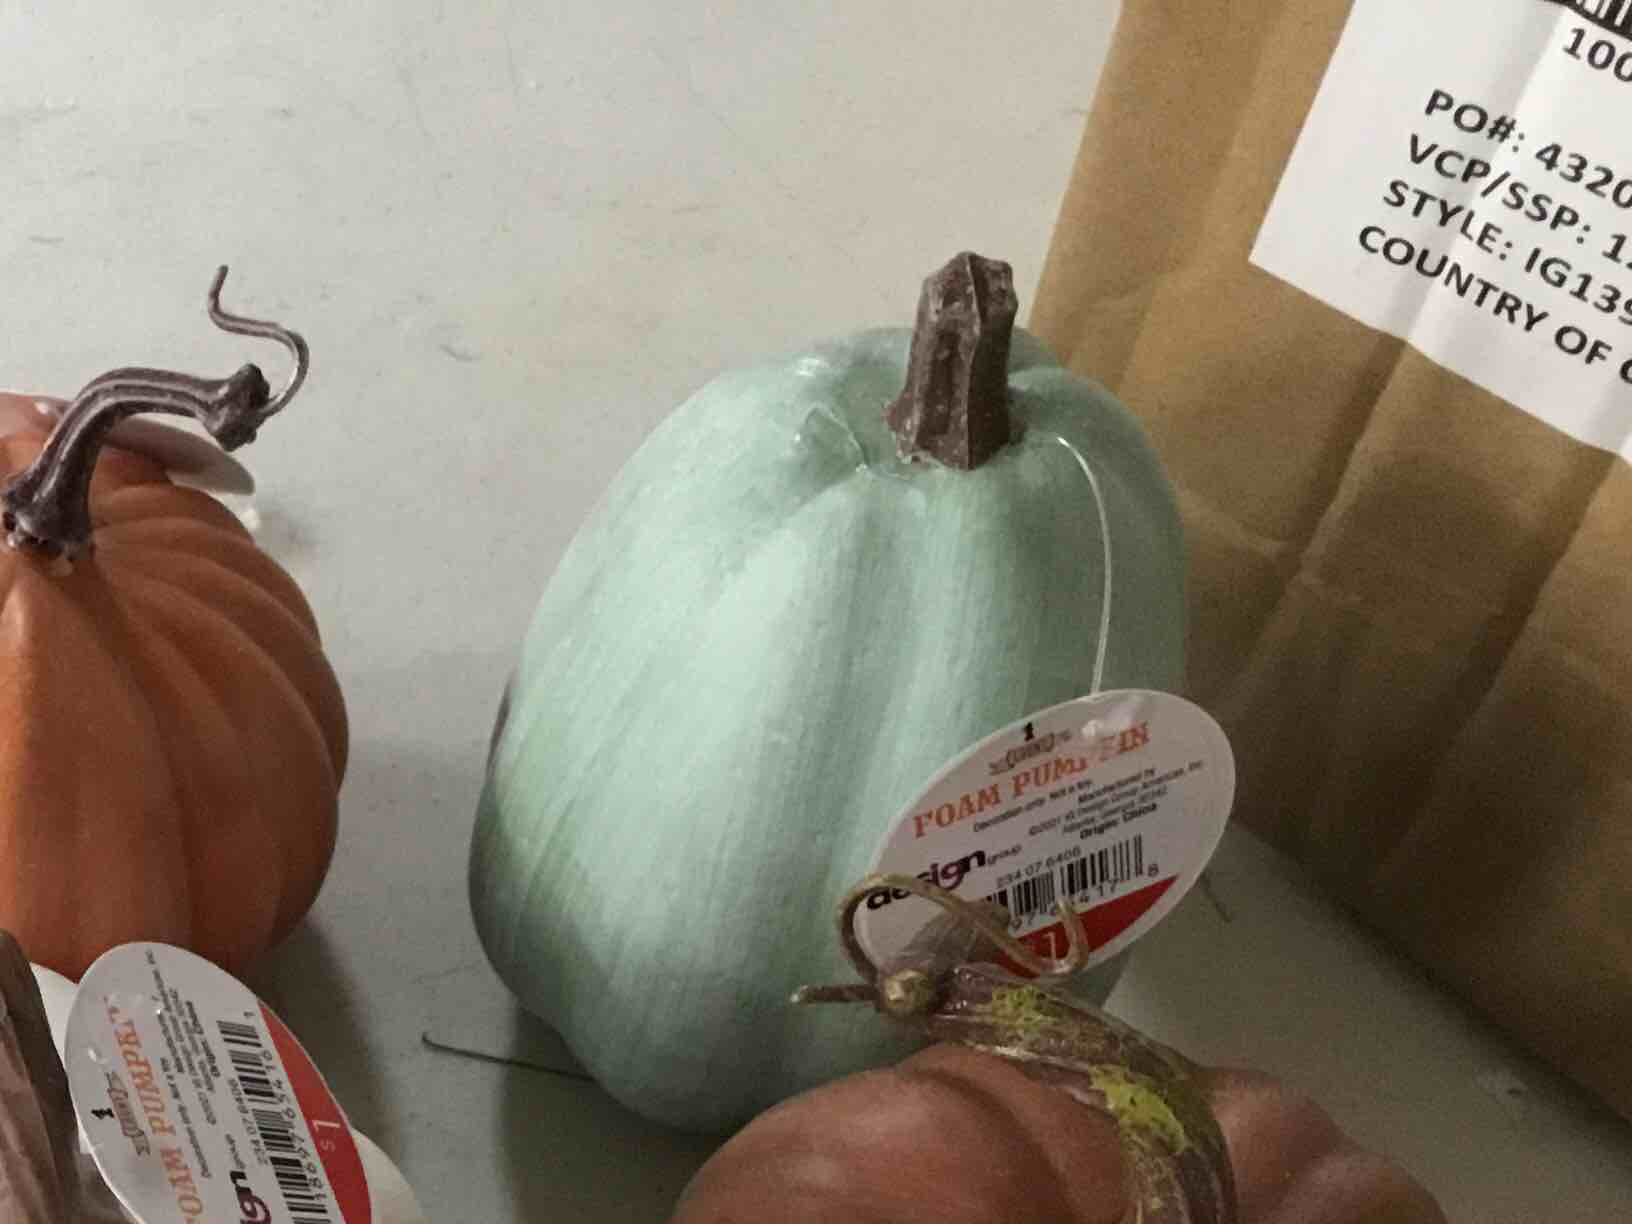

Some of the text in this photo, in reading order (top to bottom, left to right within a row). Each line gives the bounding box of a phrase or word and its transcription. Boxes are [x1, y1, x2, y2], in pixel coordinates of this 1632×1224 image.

[1424, 89, 1525, 152] PO#:
[1382, 179, 1513, 261] STYLE:
[1409, 134, 1591, 244] VCP/SSP:
[1359, 226, 1612, 365] COUNTRY OF
[1024, 722, 1035, 741] 1
[912, 782, 1002, 837] FOAM
[91, 1107, 115, 1120] 1
